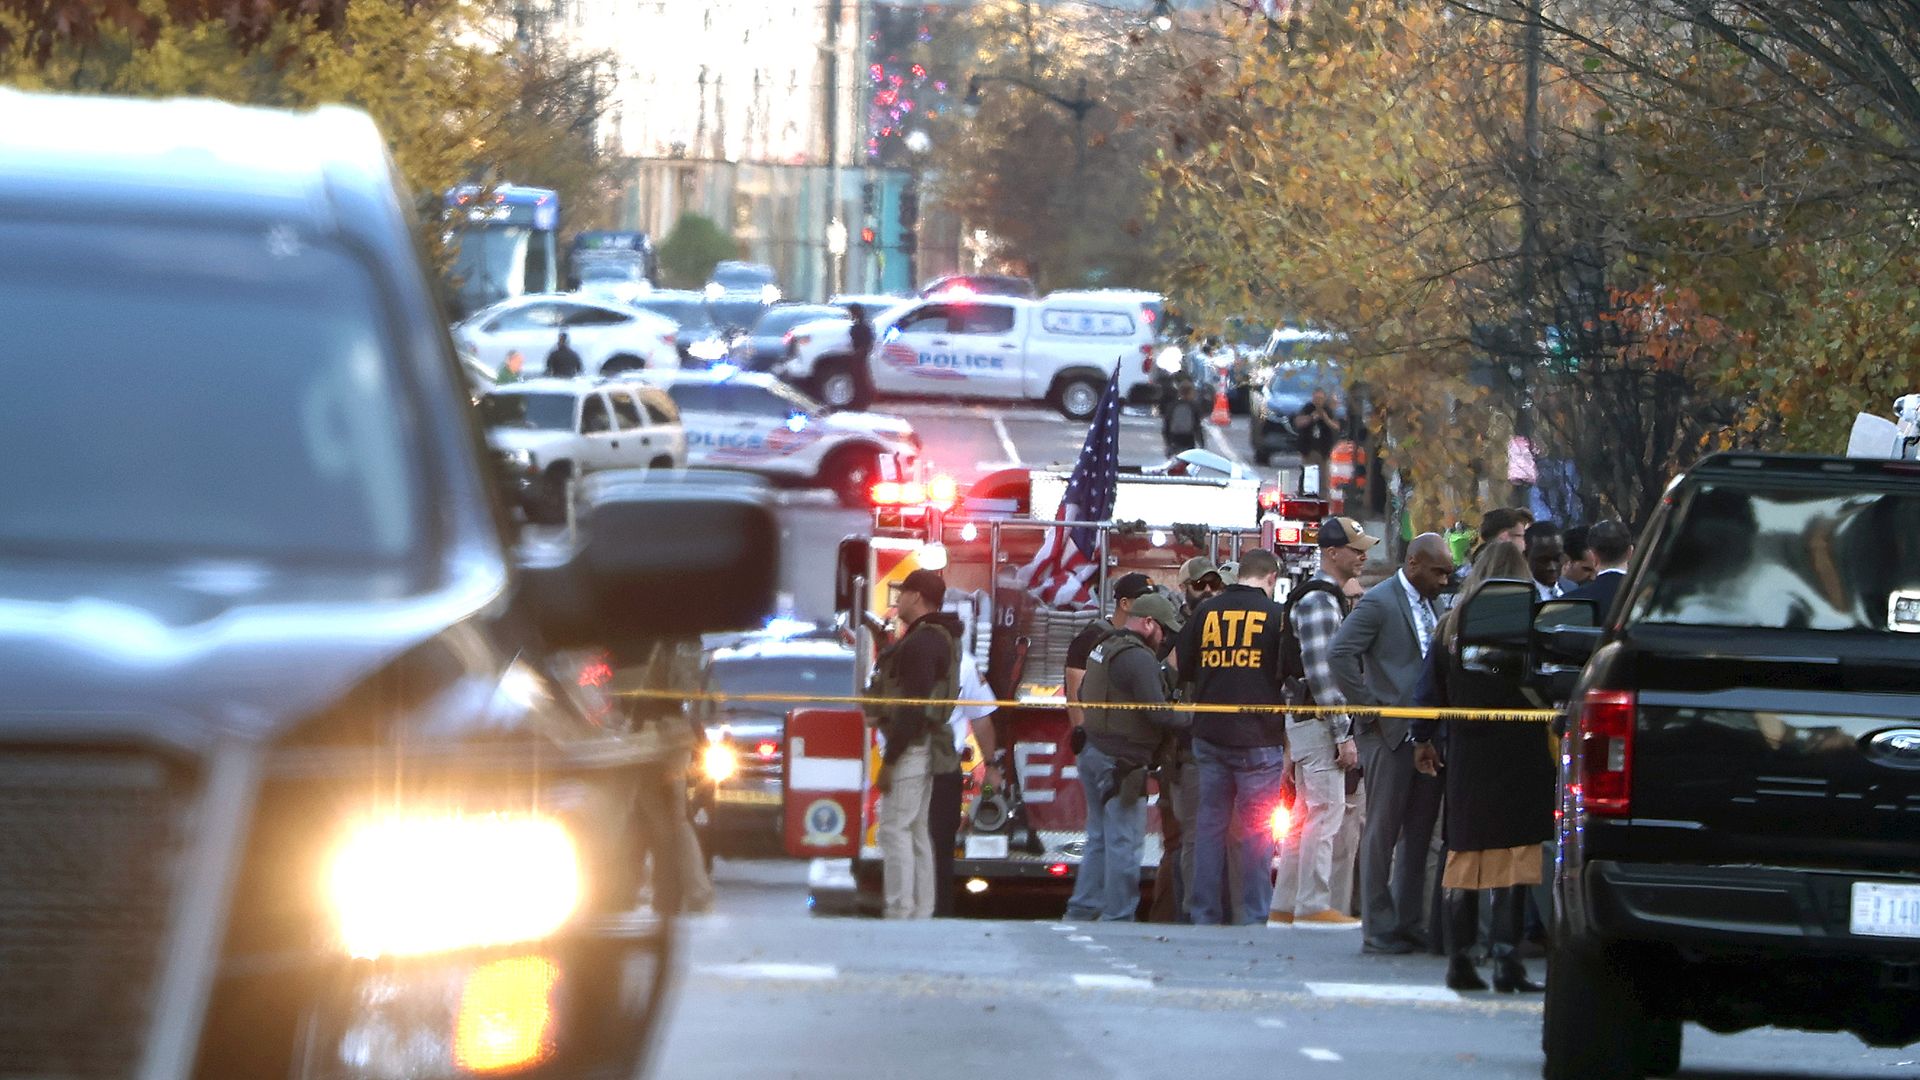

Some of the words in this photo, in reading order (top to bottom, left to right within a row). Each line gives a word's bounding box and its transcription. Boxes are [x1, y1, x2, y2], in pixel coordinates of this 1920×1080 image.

[919, 352, 1004, 368] POLICE
[686, 430, 763, 448] OLICE
[997, 606, 1014, 627] 16
[1201, 610, 1267, 648] ATF
[1201, 649, 1262, 668] POLICE
